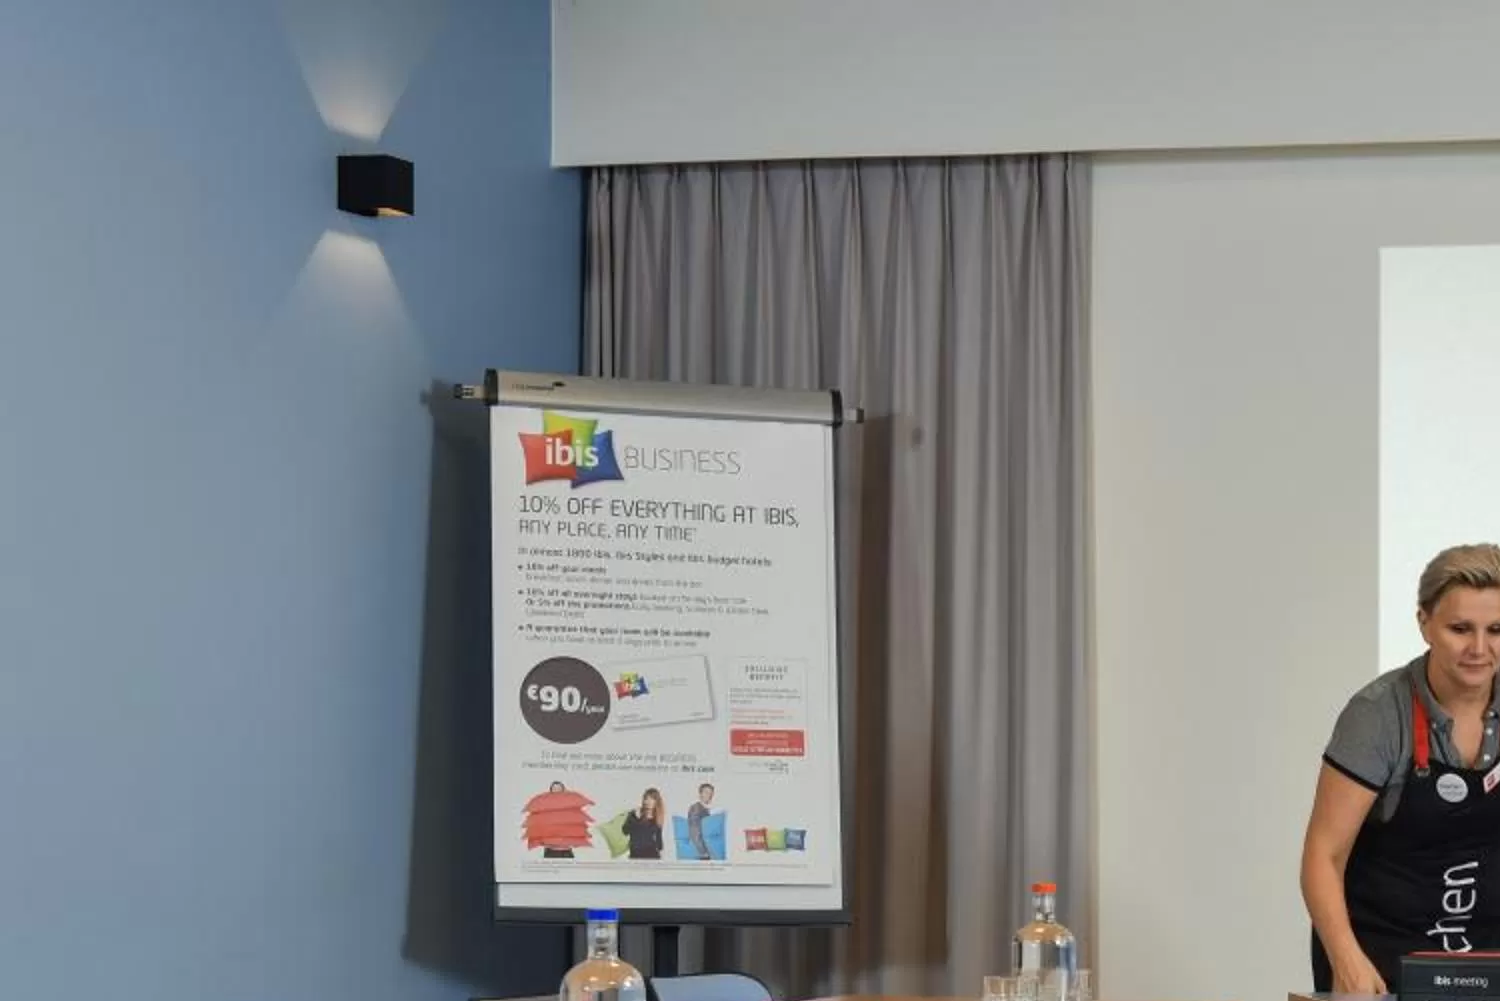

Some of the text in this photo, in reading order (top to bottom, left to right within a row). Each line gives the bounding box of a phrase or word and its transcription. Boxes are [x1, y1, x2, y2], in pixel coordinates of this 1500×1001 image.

[545, 437, 741, 475] ibis BUSINESS
[518, 495, 560, 514] 10%
[567, 497, 603, 515] OFF
[610, 499, 726, 523] EVERYTHING
[733, 505, 756, 525] AT
[519, 519, 550, 535] ANY
[615, 523, 648, 540] ANY
[1453, 976, 1489, 988] meeting
